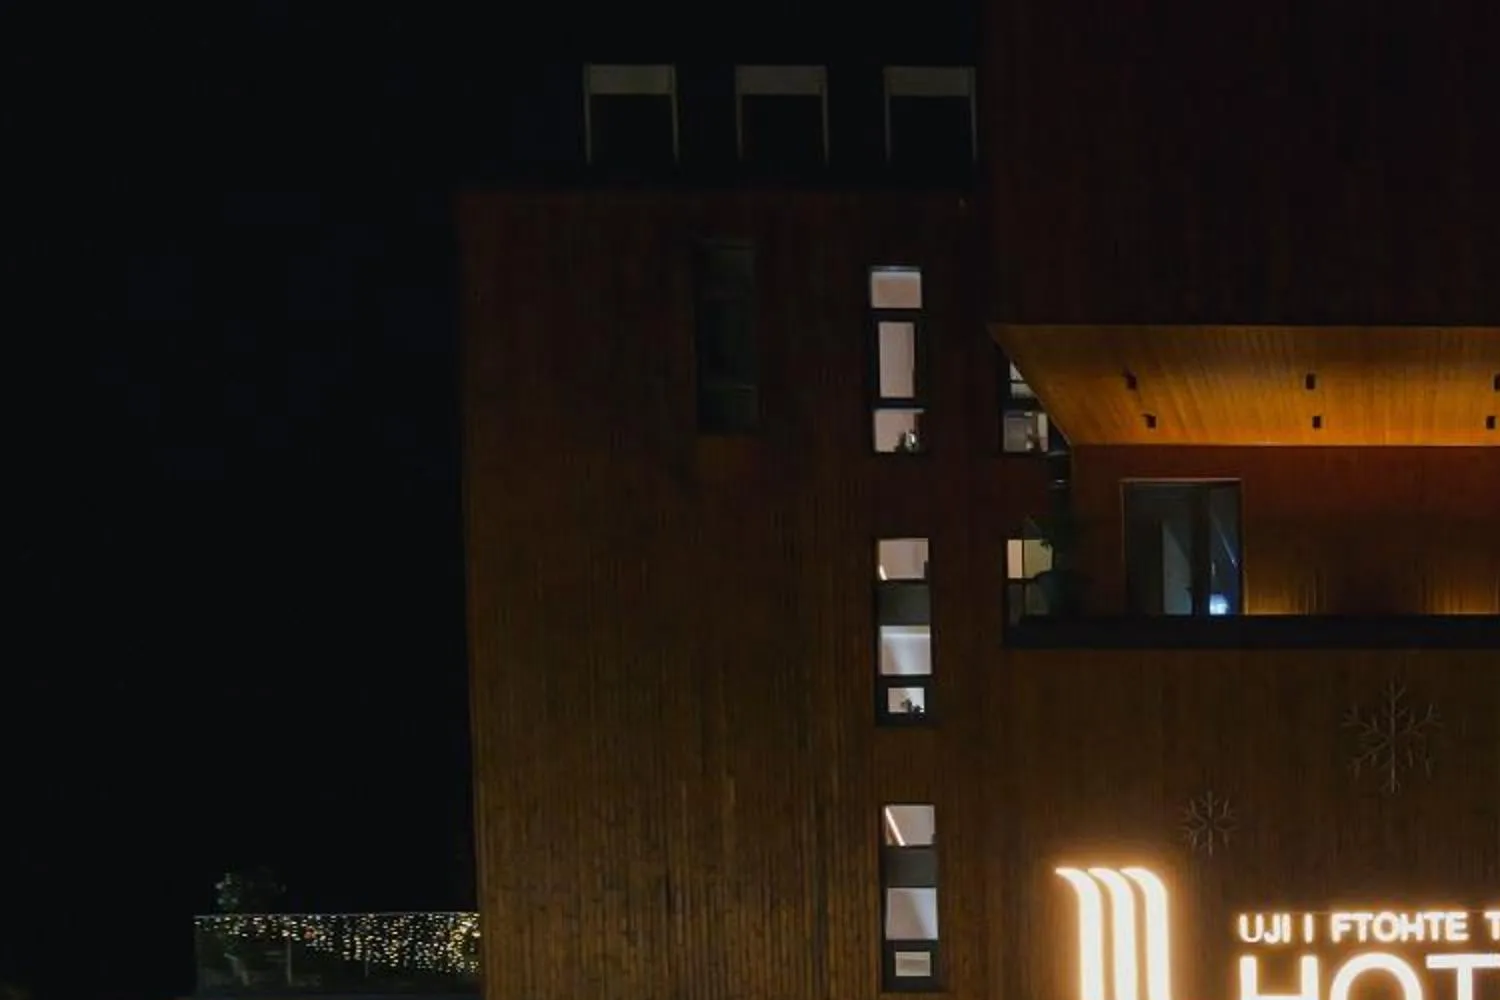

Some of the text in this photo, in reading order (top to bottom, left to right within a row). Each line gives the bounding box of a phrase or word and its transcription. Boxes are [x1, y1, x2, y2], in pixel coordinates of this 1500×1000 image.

[1239, 913, 1290, 944] UJI
[1304, 913, 1313, 943] I
[1331, 911, 1469, 942] FTOHTE
